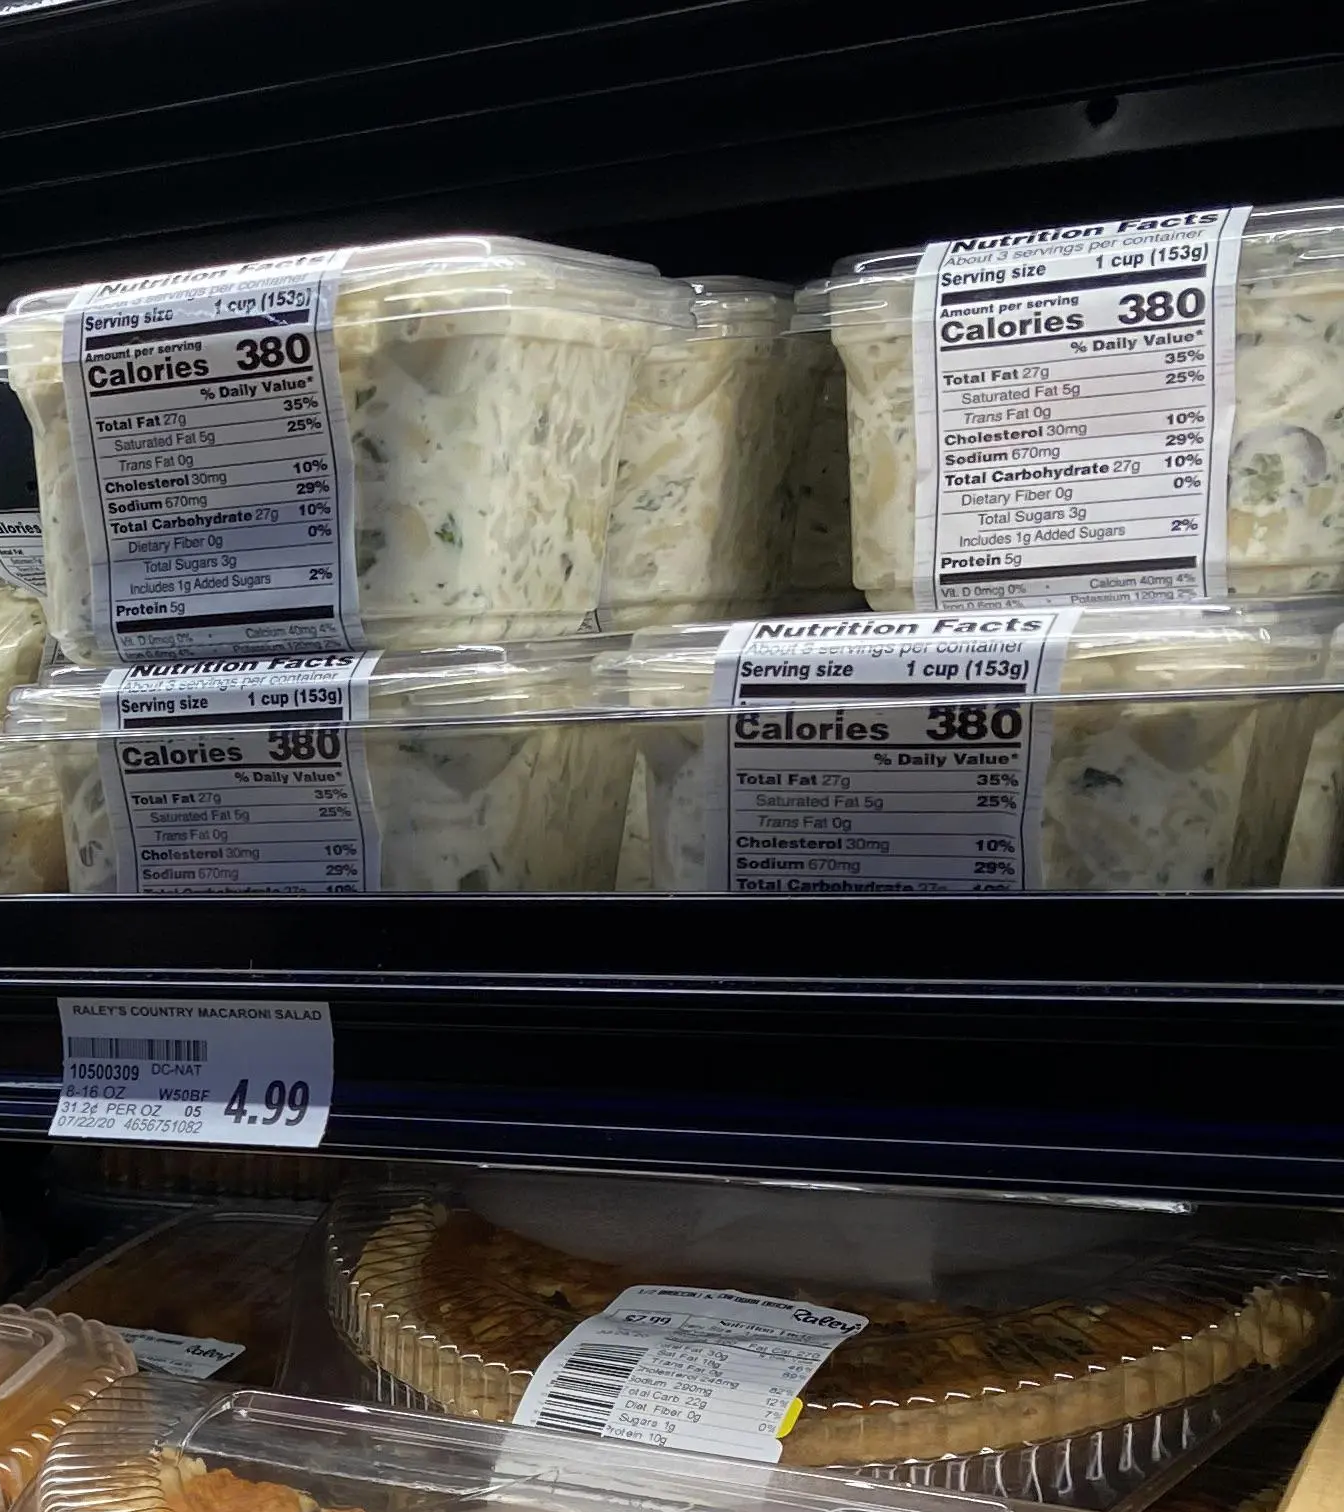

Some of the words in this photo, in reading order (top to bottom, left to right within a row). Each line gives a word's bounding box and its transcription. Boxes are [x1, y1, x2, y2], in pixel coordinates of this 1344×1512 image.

[951, 225, 1104, 254] Nutrition
[1116, 211, 1219, 233] Facts
[1096, 255, 1103, 269] 1
[1111, 253, 1144, 270] cup
[1151, 243, 1209, 265] (153g)
[942, 270, 1006, 287] Serving
[1011, 263, 1046, 279] size
[940, 305, 995, 318] Amount
[999, 301, 1023, 315] per
[1027, 295, 1079, 311] serving
[940, 312, 1085, 343] Calories
[1118, 287, 1206, 325] 380
[89, 356, 209, 388] Calories
[236, 333, 311, 371] 380
[943, 371, 986, 385] Total
[991, 368, 1018, 381] Fat
[1023, 366, 1050, 381] 27g
[1165, 350, 1204, 364] 35%
[945, 426, 1043, 447] Cholesterol
[1046, 423, 1087, 439] 30mg
[1167, 412, 1204, 426] 10%
[945, 450, 1008, 466] Sodium
[1012, 446, 1060, 461] 670mg
[1166, 432, 1203, 447] 29%
[945, 472, 987, 486] Total
[991, 461, 1109, 484] Carbohydrate
[1113, 459, 1140, 475] 27g
[1164, 454, 1202, 468] 10%
[941, 554, 1001, 569] Protein
[1005, 552, 1022, 567] 5g
[754, 618, 918, 639] Nutrition
[927, 616, 1044, 635] Facts
[129, 655, 259, 679] Nutrition
[266, 653, 355, 672] Facts
[741, 661, 811, 680] Serving
[816, 661, 853, 678] size
[906, 661, 915, 677] 1
[923, 661, 959, 680] cup
[966, 659, 1029, 681] (153g)
[121, 696, 174, 715] Serving
[179, 694, 208, 710] size
[735, 709, 890, 741] Calories
[925, 704, 1022, 740] 380
[122, 743, 244, 767] Calories
[72, 1005, 127, 1017] RALEY'S
[130, 1006, 193, 1018] COUNTRY
[198, 1007, 271, 1019] MACARONI
[274, 1009, 322, 1021] SALAD
[69, 1064, 140, 1081] 10500309
[151, 1063, 202, 1076] DC-NAT
[65, 1085, 98, 1099] 8-16
[103, 1086, 126, 1099] OZ
[224, 1078, 310, 1127] 4.99
[57, 1116, 115, 1129] 07/22/20
[106, 1104, 136, 1116] PER
[140, 1105, 162, 1117] OZ
